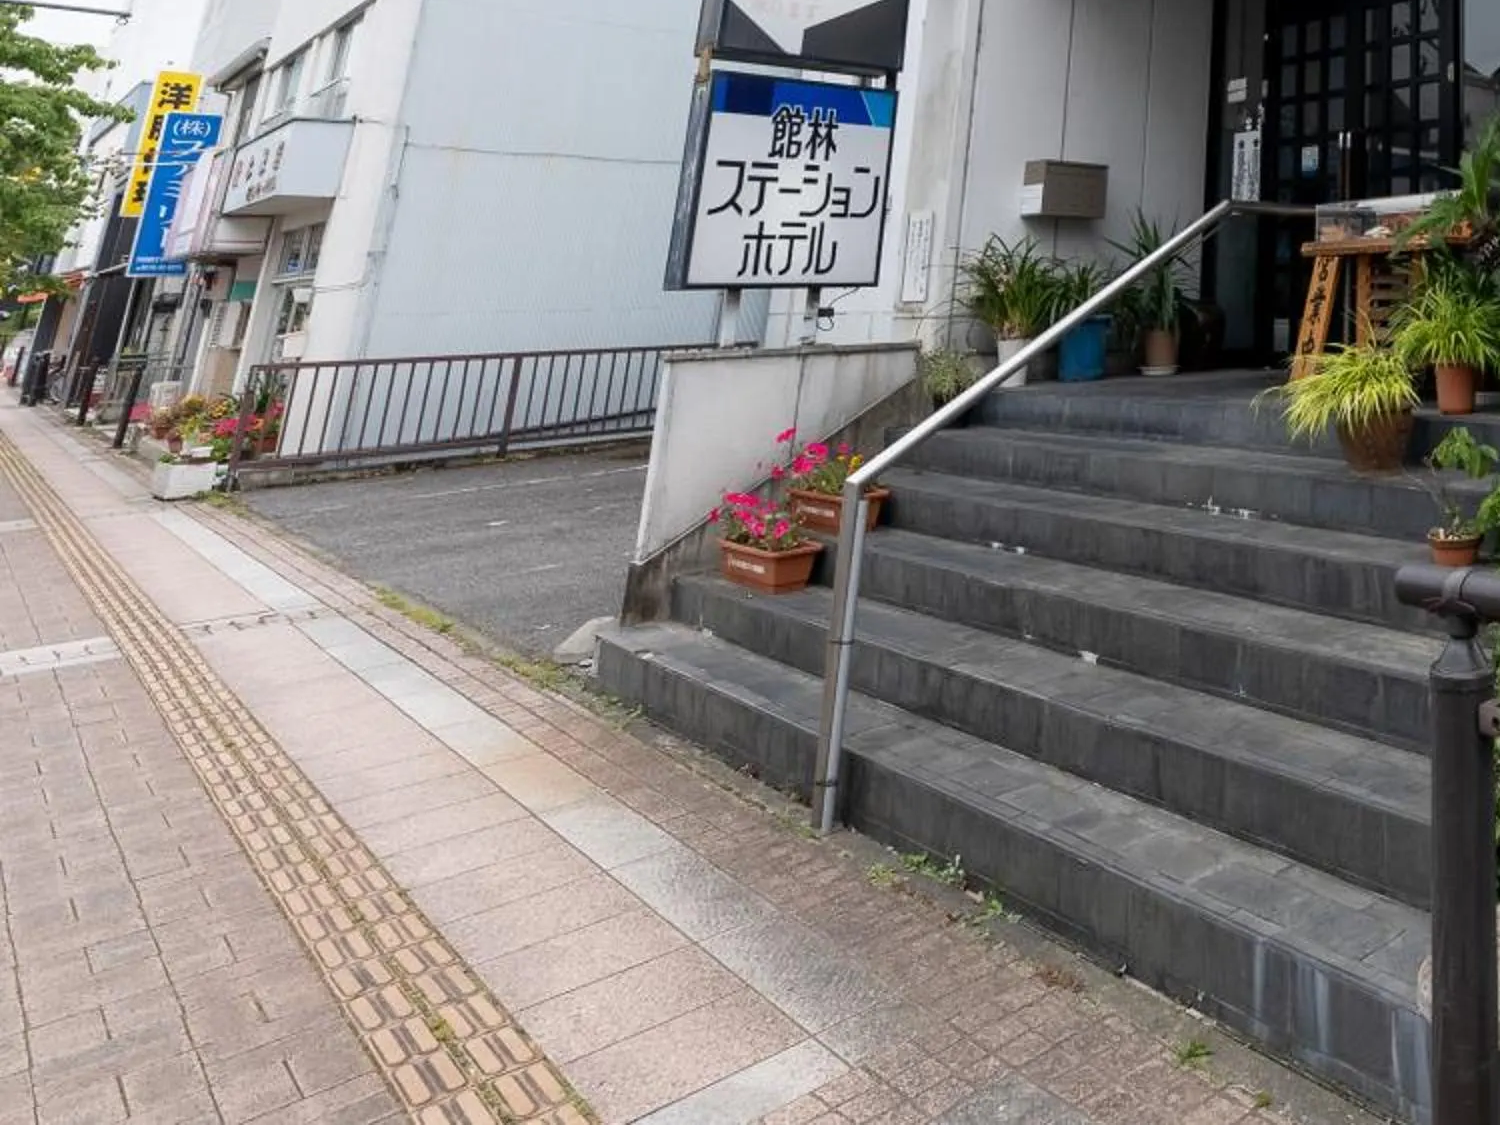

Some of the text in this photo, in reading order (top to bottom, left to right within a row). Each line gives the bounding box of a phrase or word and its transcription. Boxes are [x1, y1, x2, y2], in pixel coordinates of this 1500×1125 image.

[768, 105, 839, 162] 館林
[706, 161, 881, 219] ステーション
[736, 220, 838, 278] ホテル
